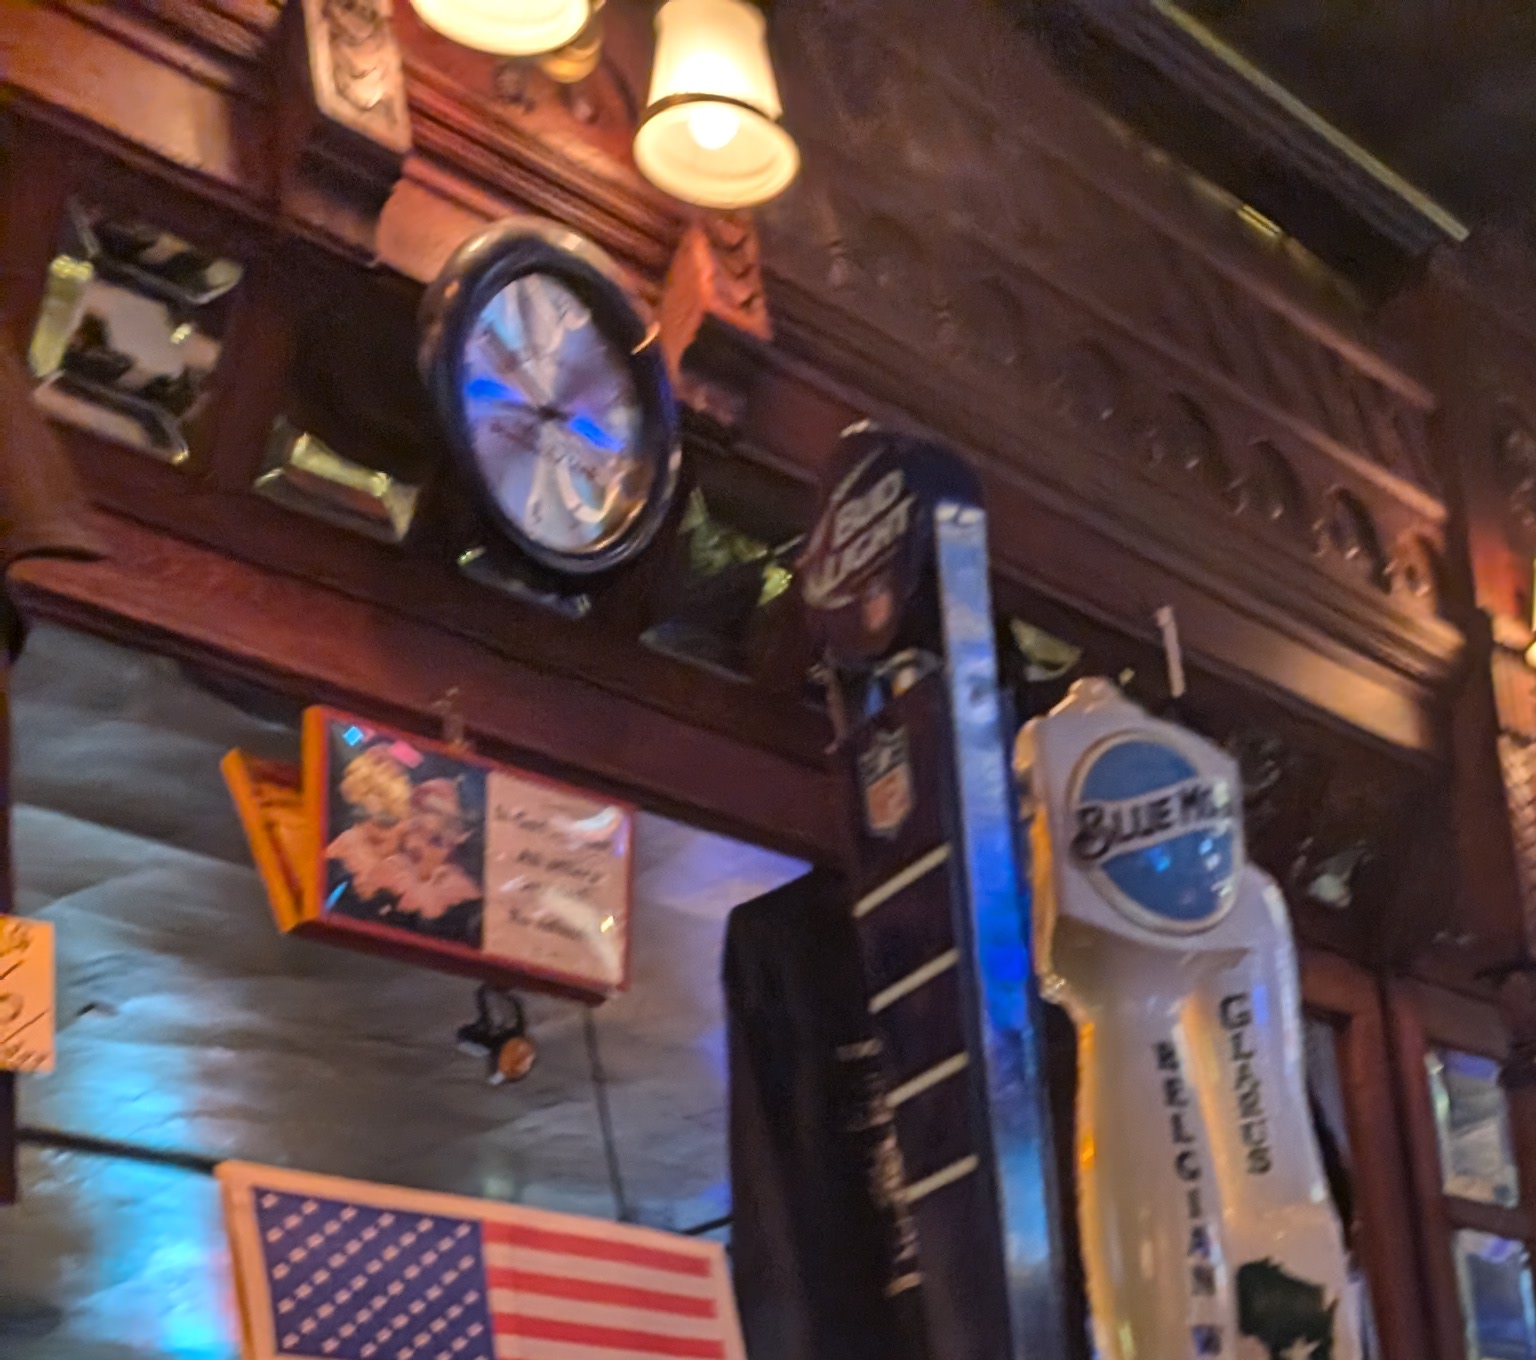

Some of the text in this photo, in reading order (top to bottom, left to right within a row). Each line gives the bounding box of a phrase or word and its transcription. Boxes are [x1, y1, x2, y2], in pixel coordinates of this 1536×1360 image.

[832, 468, 905, 549] BUD
[804, 493, 918, 608] LIGHT
[1070, 797, 1176, 861] BLUE
